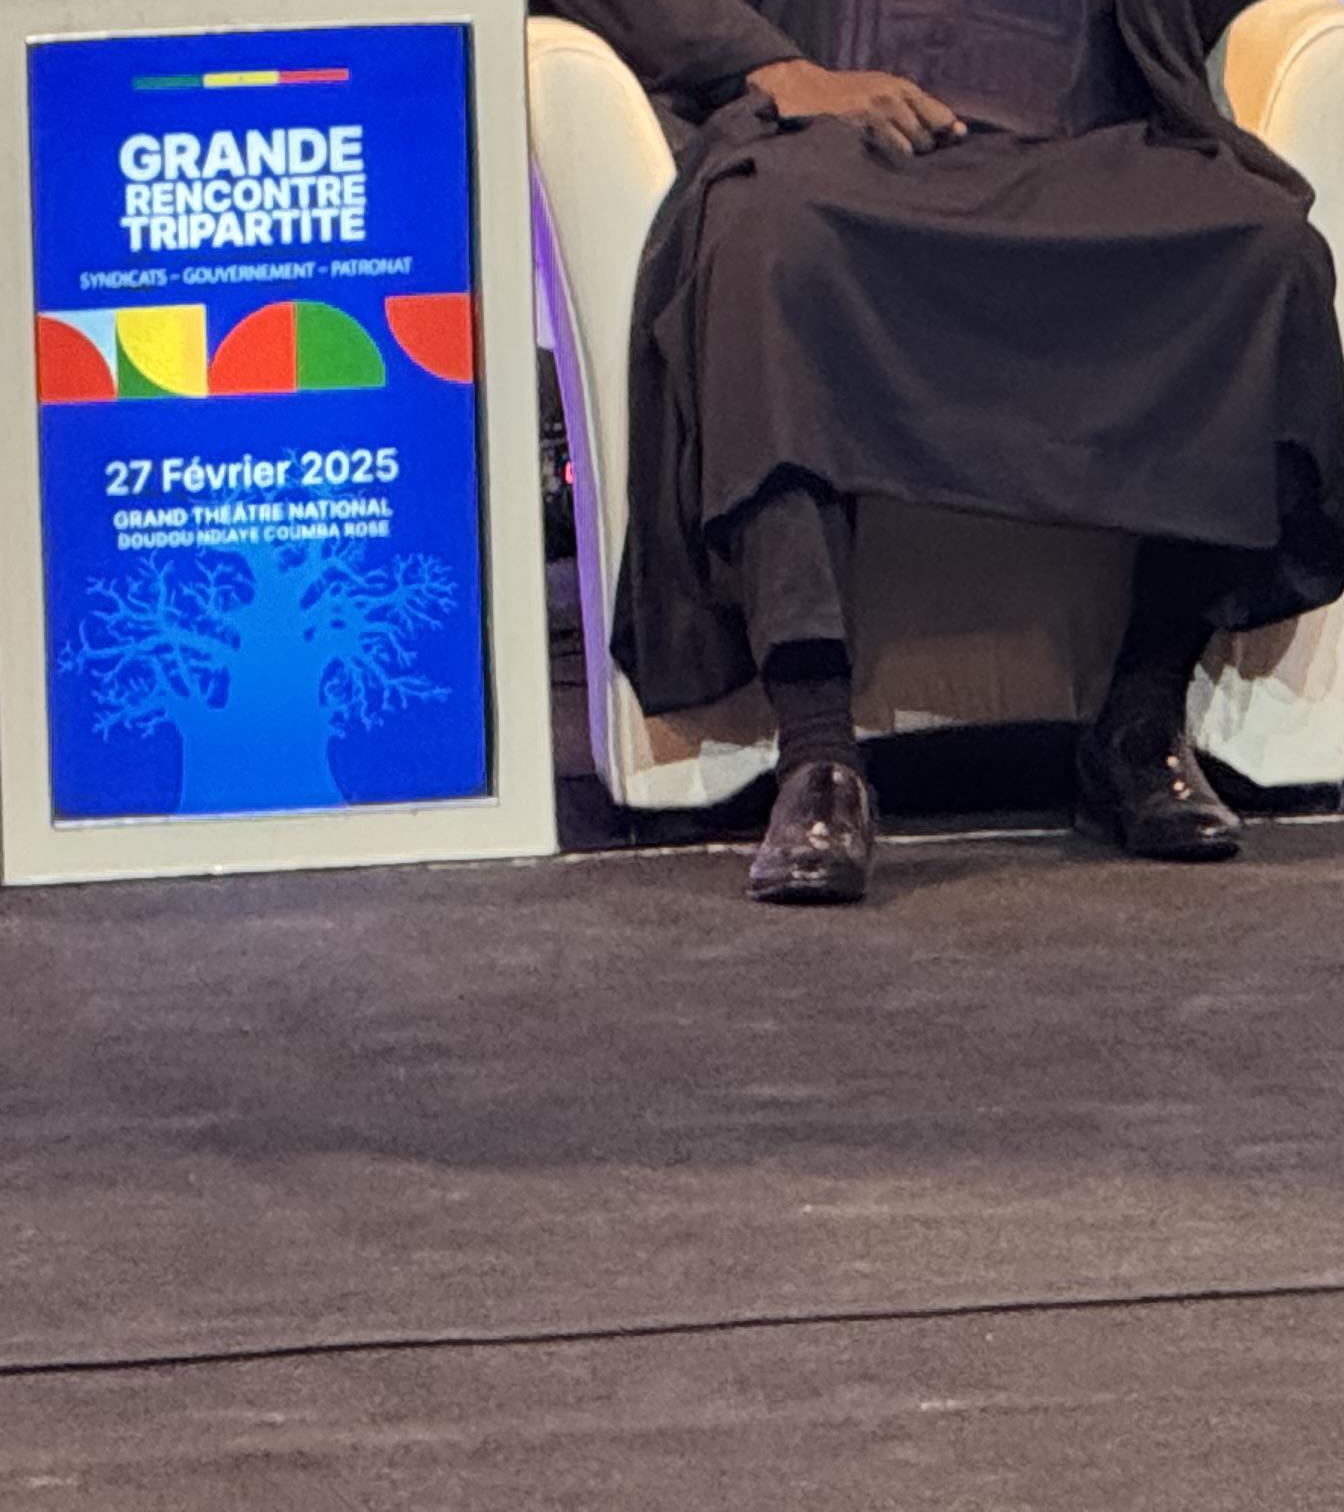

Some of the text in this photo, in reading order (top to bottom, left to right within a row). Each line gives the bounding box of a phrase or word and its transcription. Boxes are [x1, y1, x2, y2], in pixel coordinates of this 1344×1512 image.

[119, 125, 366, 183] GRANDE
[125, 173, 366, 217] RENCONTRE
[120, 206, 366, 252] TRIPARTITE
[79, 268, 168, 290] SYNDICATS
[182, 261, 316, 285] GOUVERNEMENT
[330, 256, 412, 276] PATRONAT
[105, 447, 399, 496] 27 Février 2025
[113, 508, 188, 530] GRAND
[287, 497, 393, 522] NATIONAL
